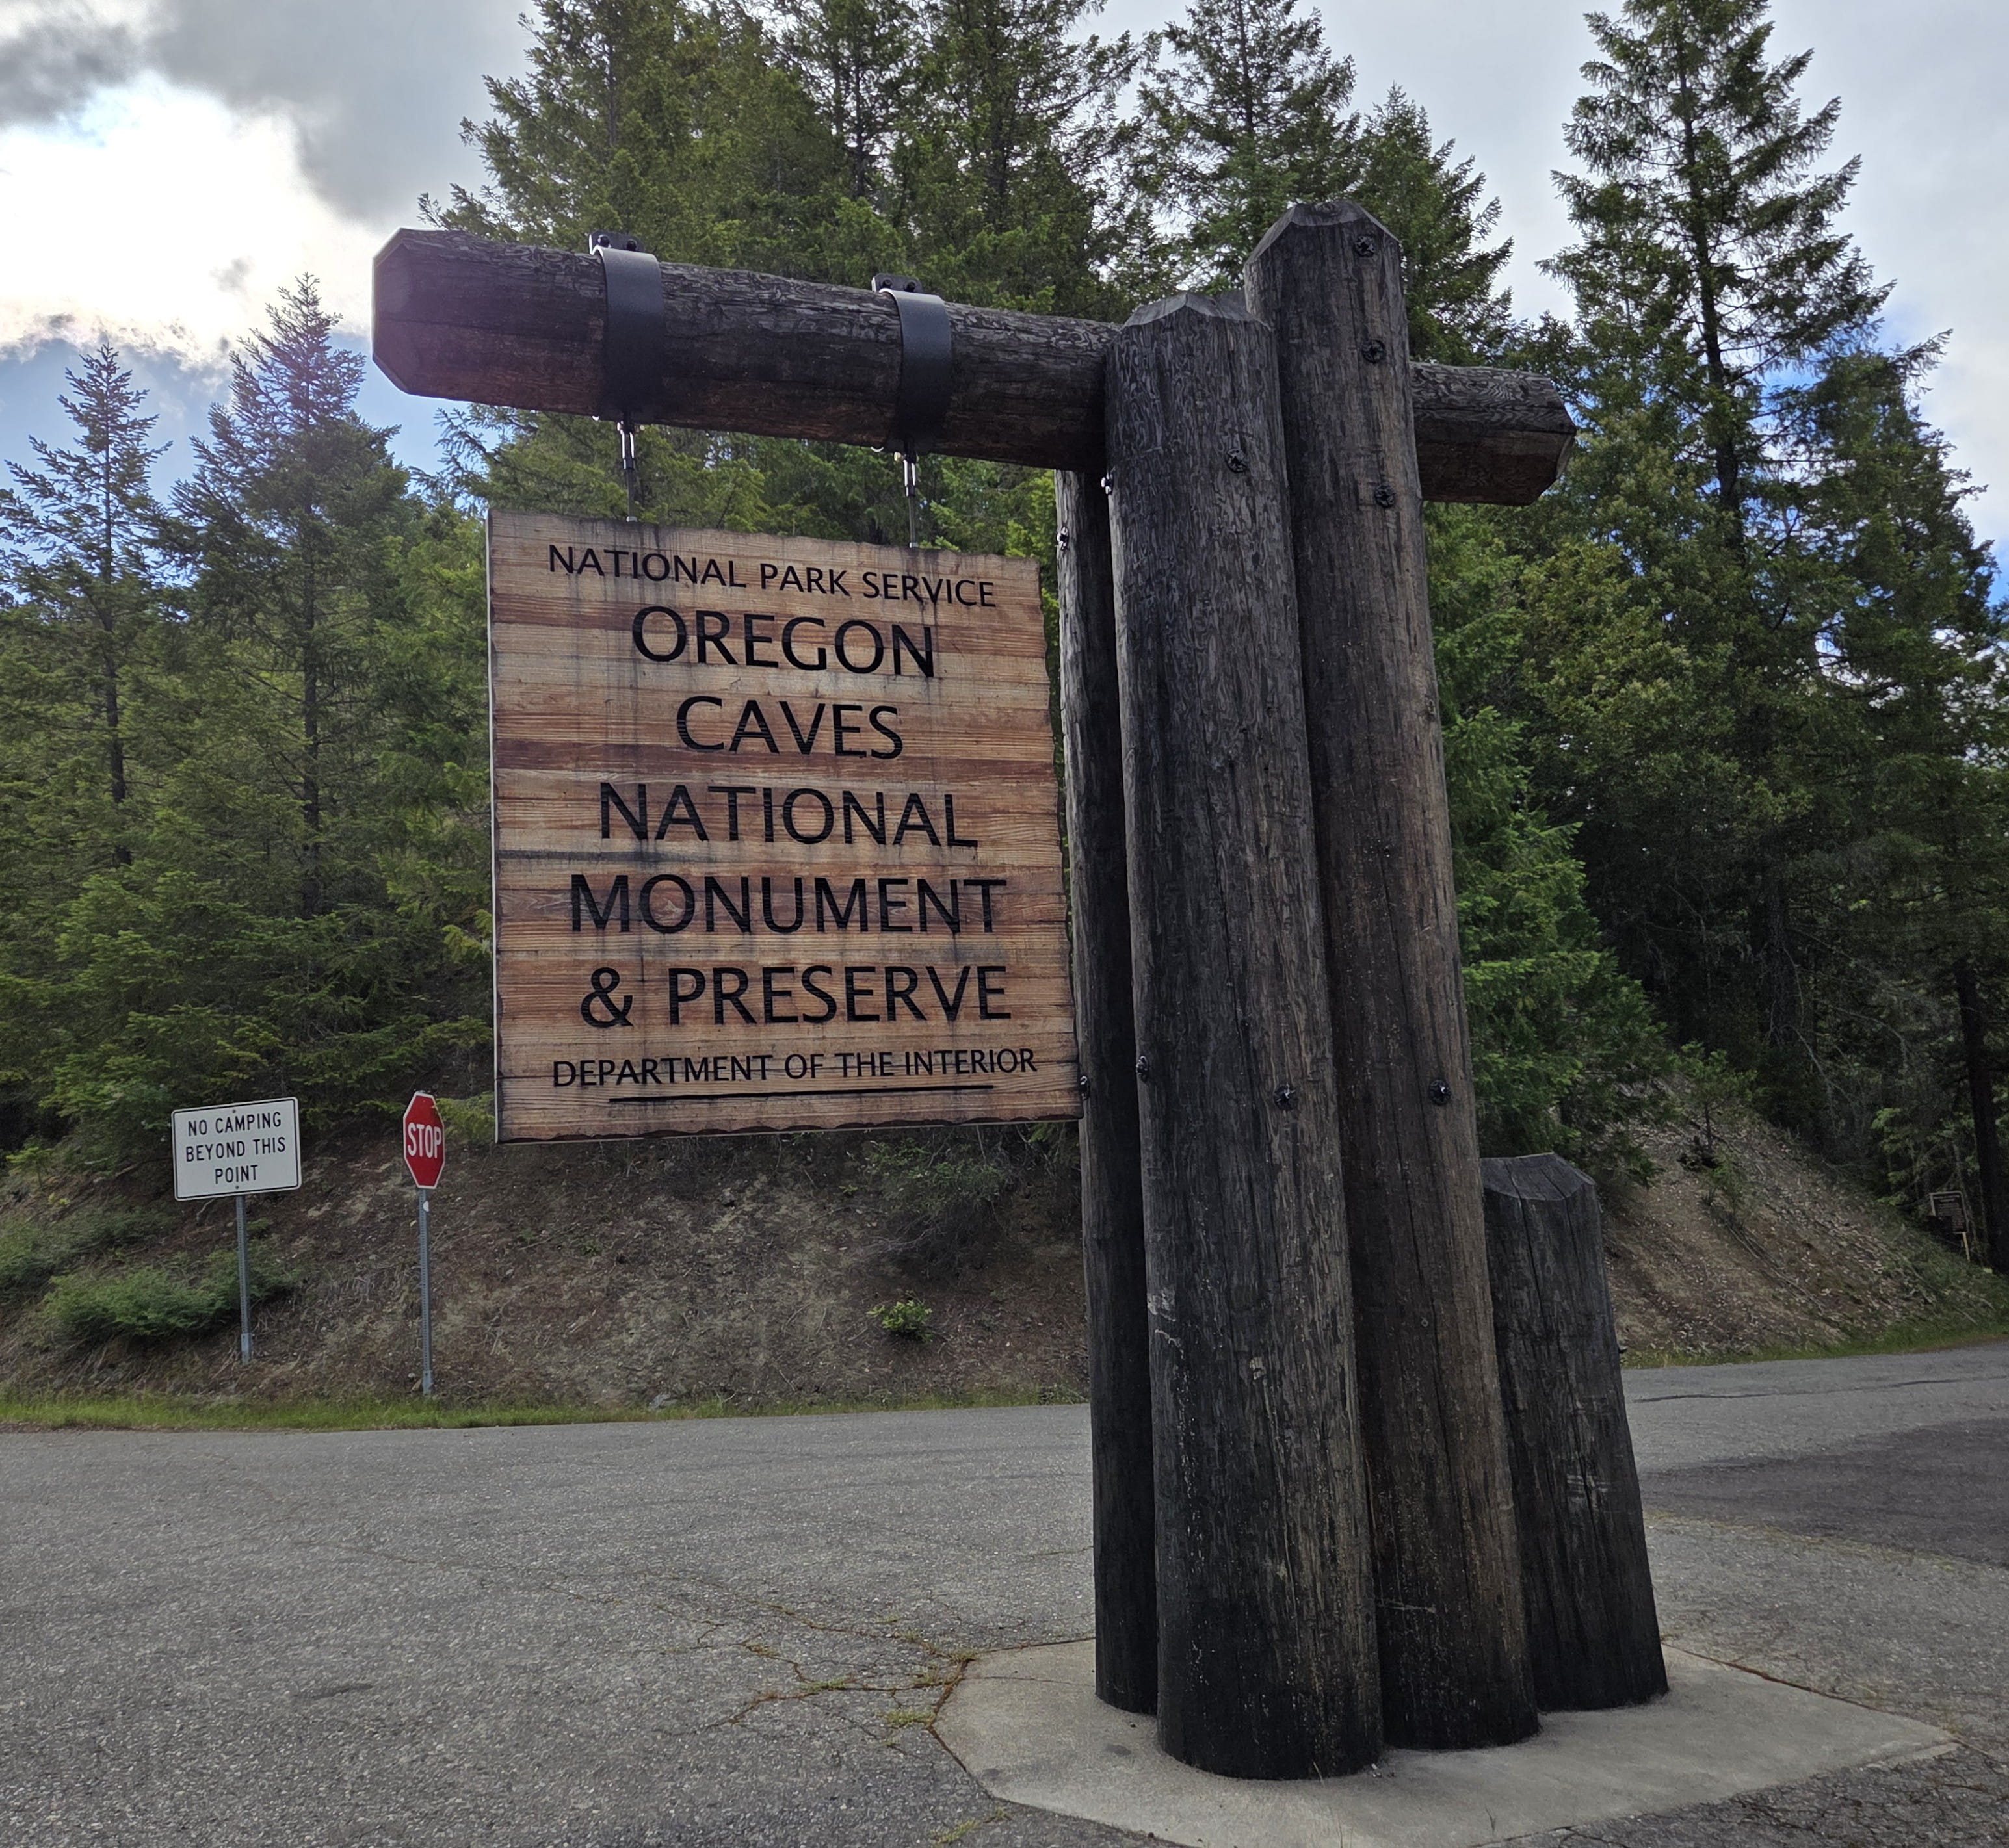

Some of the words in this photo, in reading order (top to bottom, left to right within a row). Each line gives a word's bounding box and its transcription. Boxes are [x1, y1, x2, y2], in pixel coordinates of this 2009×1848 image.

[549, 545, 746, 588] NATIONAL
[760, 563, 850, 597] PARK
[862, 571, 997, 608] SERVICE
[632, 606, 934, 678] OREGON
[677, 696, 904, 760] CAVES
[600, 783, 978, 848] NATIONAL
[570, 874, 1008, 935] MONUMENT
[580, 967, 633, 1028] &
[668, 965, 1012, 1026] PRESERVE
[553, 1054, 773, 1087] DEPARTMENT
[784, 1053, 824, 1080] OF
[834, 1051, 893, 1077] THE
[906, 1047, 1038, 1076] INTERIOR
[186, 1139, 246, 1162] BEYOND
[253, 1136, 286, 1156] THIS
[188, 1119, 207, 1137] NO
[215, 1112, 282, 1134] CAMPING
[408, 1122, 442, 1159] STOP
[215, 1164, 258, 1185] POINT
